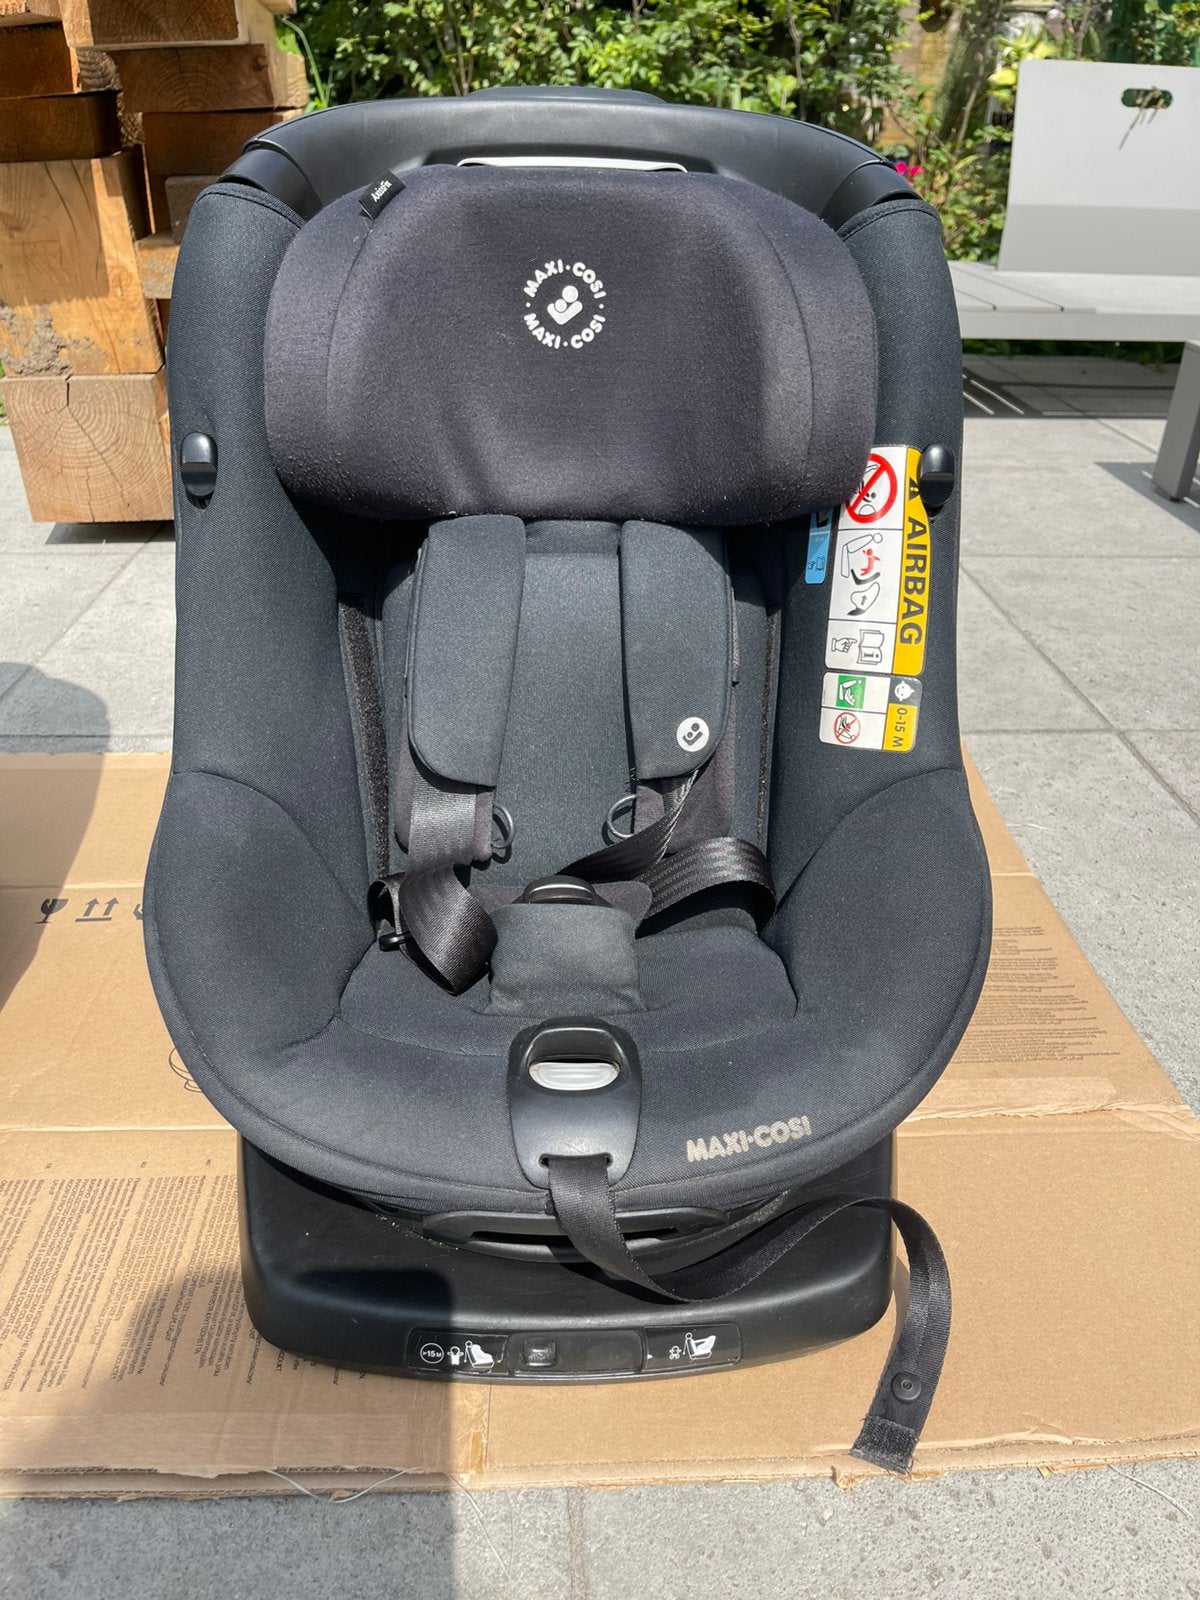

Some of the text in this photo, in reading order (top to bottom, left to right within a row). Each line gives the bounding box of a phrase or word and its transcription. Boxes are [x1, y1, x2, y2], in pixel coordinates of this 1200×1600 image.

[900, 516, 927, 645] AIRBAG
[892, 707, 908, 748] 0-15 M
